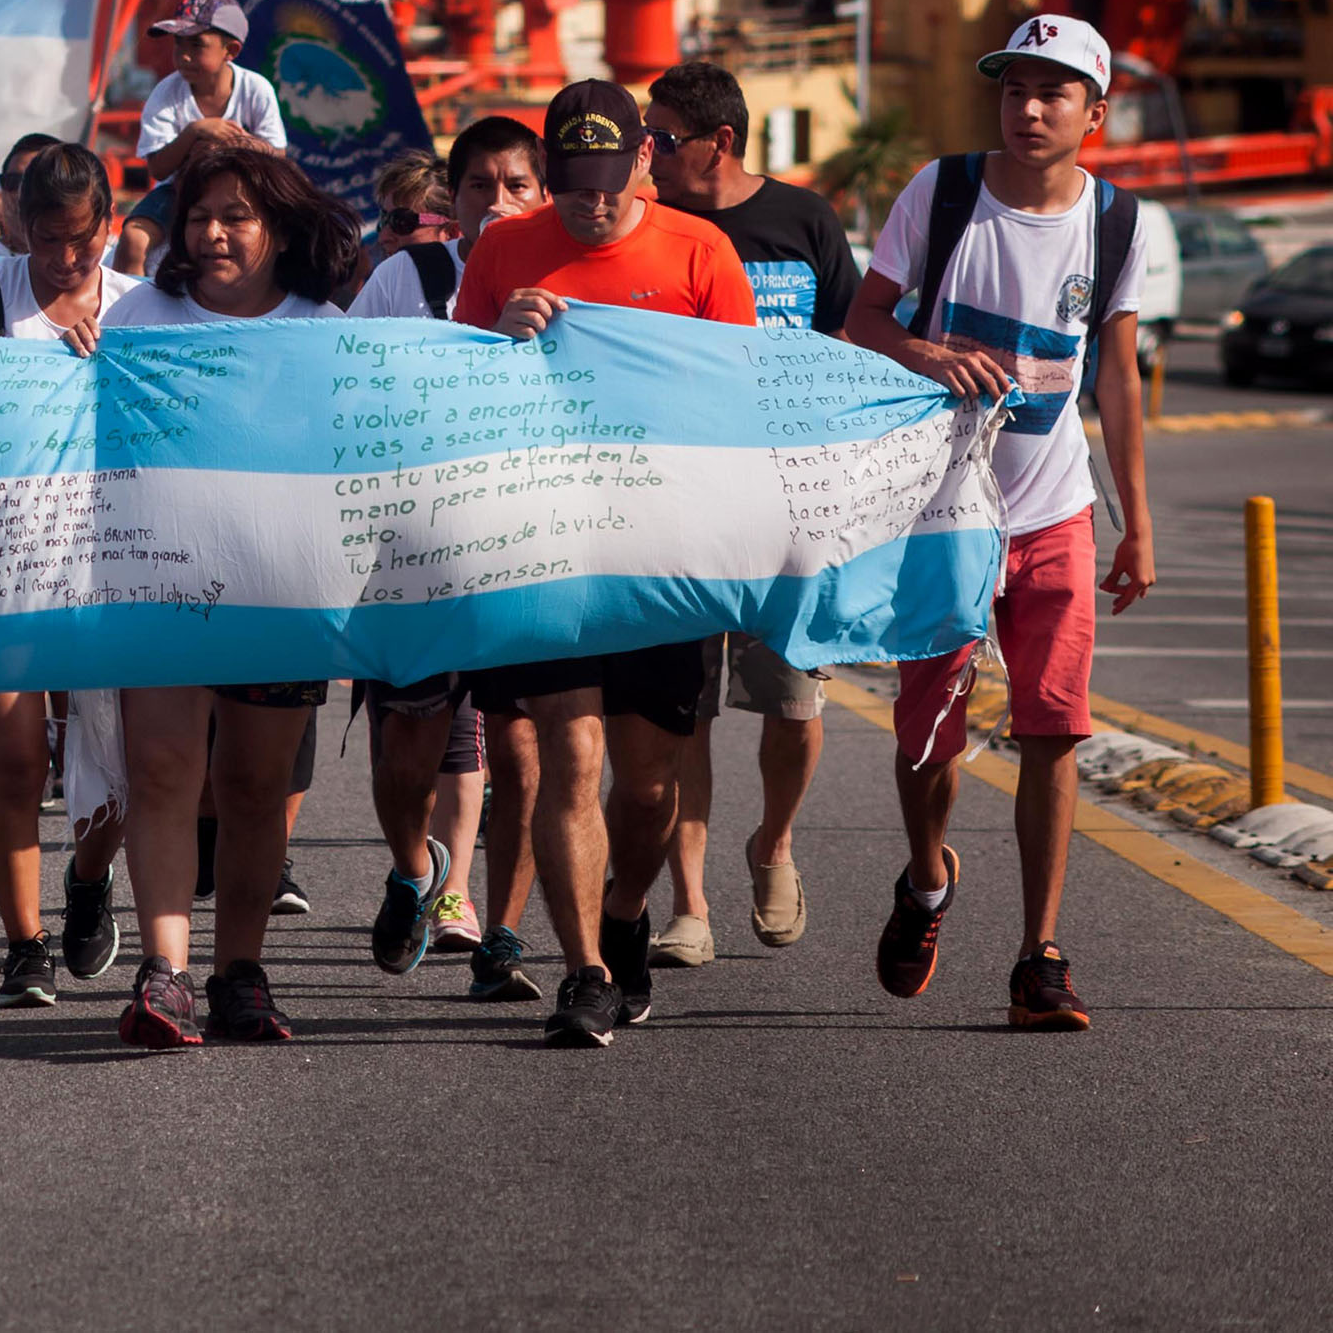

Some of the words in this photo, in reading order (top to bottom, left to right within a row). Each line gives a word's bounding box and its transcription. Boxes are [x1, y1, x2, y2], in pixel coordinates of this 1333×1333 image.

[755, 293, 798, 308] ANTE
[756, 314, 803, 329] AMAYO
[332, 375, 359, 397] yo
[369, 375, 396, 392] se
[413, 374, 460, 404] que
[468, 371, 510, 388] nos
[519, 369, 596, 387] vamos
[353, 404, 432, 430] volver
[444, 407, 458, 424] a
[468, 394, 596, 422] encontrar
[356, 438, 404, 459] vas
[420, 435, 435, 451] a
[445, 426, 508, 447] sacar
[518, 417, 545, 439] tu
[551, 413, 647, 449] guitarra
[334, 475, 381, 497] con
[390, 461, 424, 489] tu
[433, 459, 490, 485] vaso
[596, 450, 622, 465] en
[629, 445, 649, 465] la
[339, 498, 417, 523] mano
[429, 487, 488, 527] para
[581, 469, 604, 487] de
[610, 466, 663, 488] todo
[390, 533, 509, 571] hermanos
